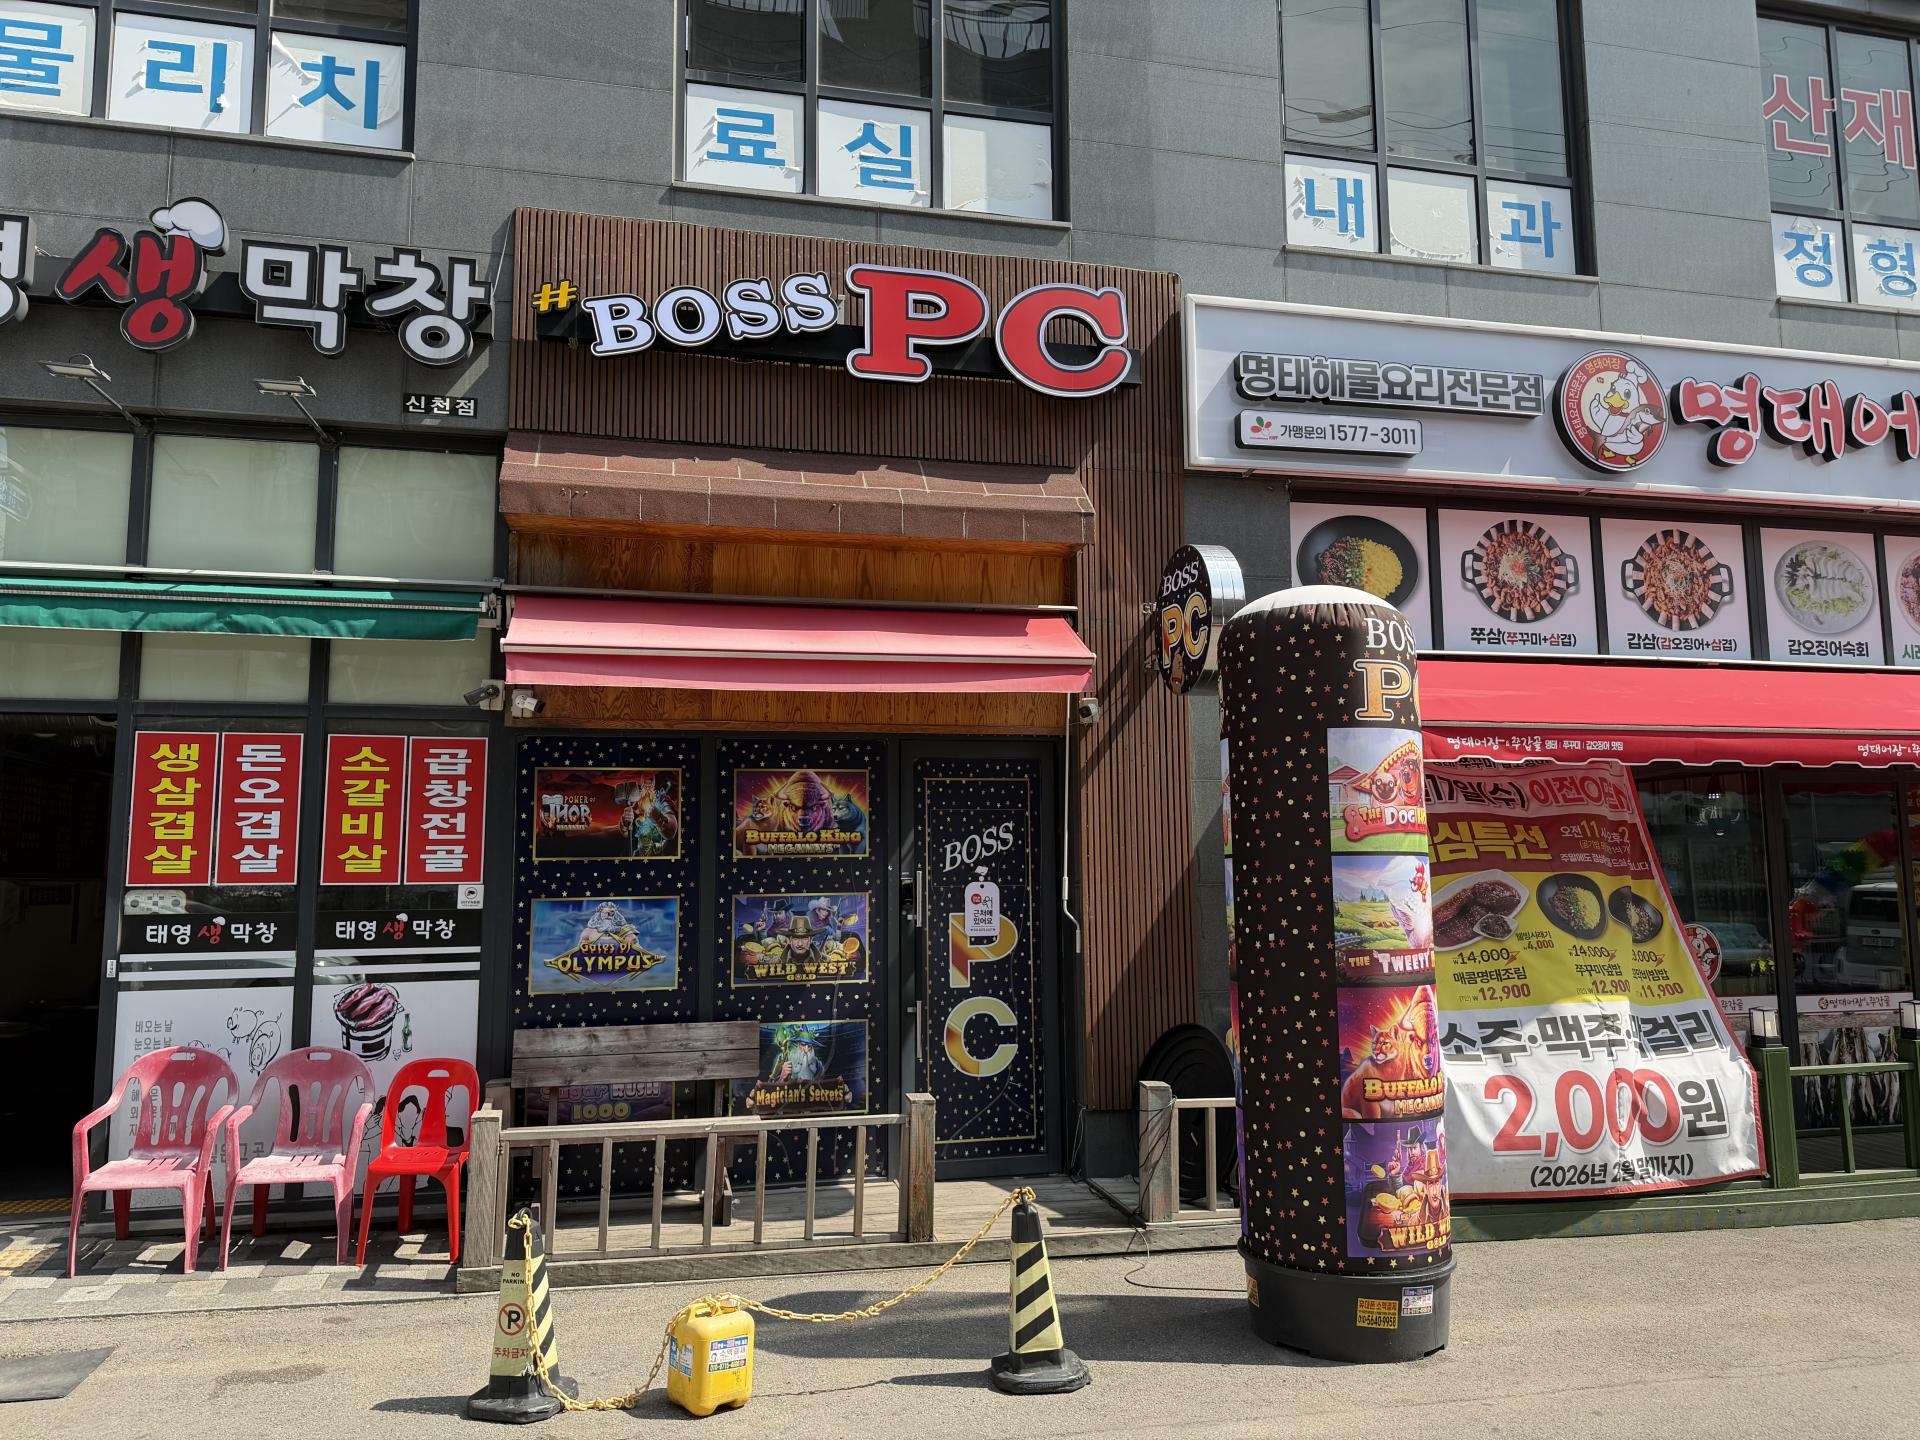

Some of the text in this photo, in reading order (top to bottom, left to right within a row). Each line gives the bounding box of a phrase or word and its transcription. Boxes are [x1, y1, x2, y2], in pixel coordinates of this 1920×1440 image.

[1762, 74, 1917, 170] 산재
[845, 263, 1133, 399] PC
[1240, 352, 1543, 413] 명태해물요리전문점
[405, 395, 475, 417] 신천점
[1280, 424, 1417, 445] 가맹문의 1577-3011
[1162, 561, 1200, 598] BOSS
[1161, 591, 1209, 670] PC
[1363, 617, 1417, 656] BOS
[1470, 626, 1577, 648] 쭈삼(쭈꾸미+삼겹)
[1626, 632, 1738, 653] 갑삼(갑오징어+삼겹)
[1786, 638, 1870, 658] 갑오징어숙회
[1353, 658, 1421, 727] P
[1447, 736, 1505, 750] 명태어장
[143, 743, 202, 875] 생삼겹살
[232, 743, 287, 873] 돈오겹살
[336, 745, 391, 873] 소갈비살
[419, 747, 473, 873] 곱창전골
[564, 795, 589, 804] POWER
[1384, 806, 1416, 825] DOG
[943, 820, 1016, 874] BOSS
[1430, 820, 1552, 862] 심특선
[557, 954, 653, 973] OLYMPUS
[753, 962, 798, 977] WILD
[1348, 955, 1371, 968] THE
[1377, 947, 1431, 974] TWEETY
[786, 973, 817, 981] GOLD
[1453, 966, 1528, 985] 매콤명태조림
[756, 1084, 844, 1106] Magician's Secrets
[571, 1102, 631, 1122] 1000
[1484, 1067, 1729, 1159] 2,000원
[1530, 1162, 1608, 1188] (2026년
[1388, 1222, 1435, 1248] WILD
